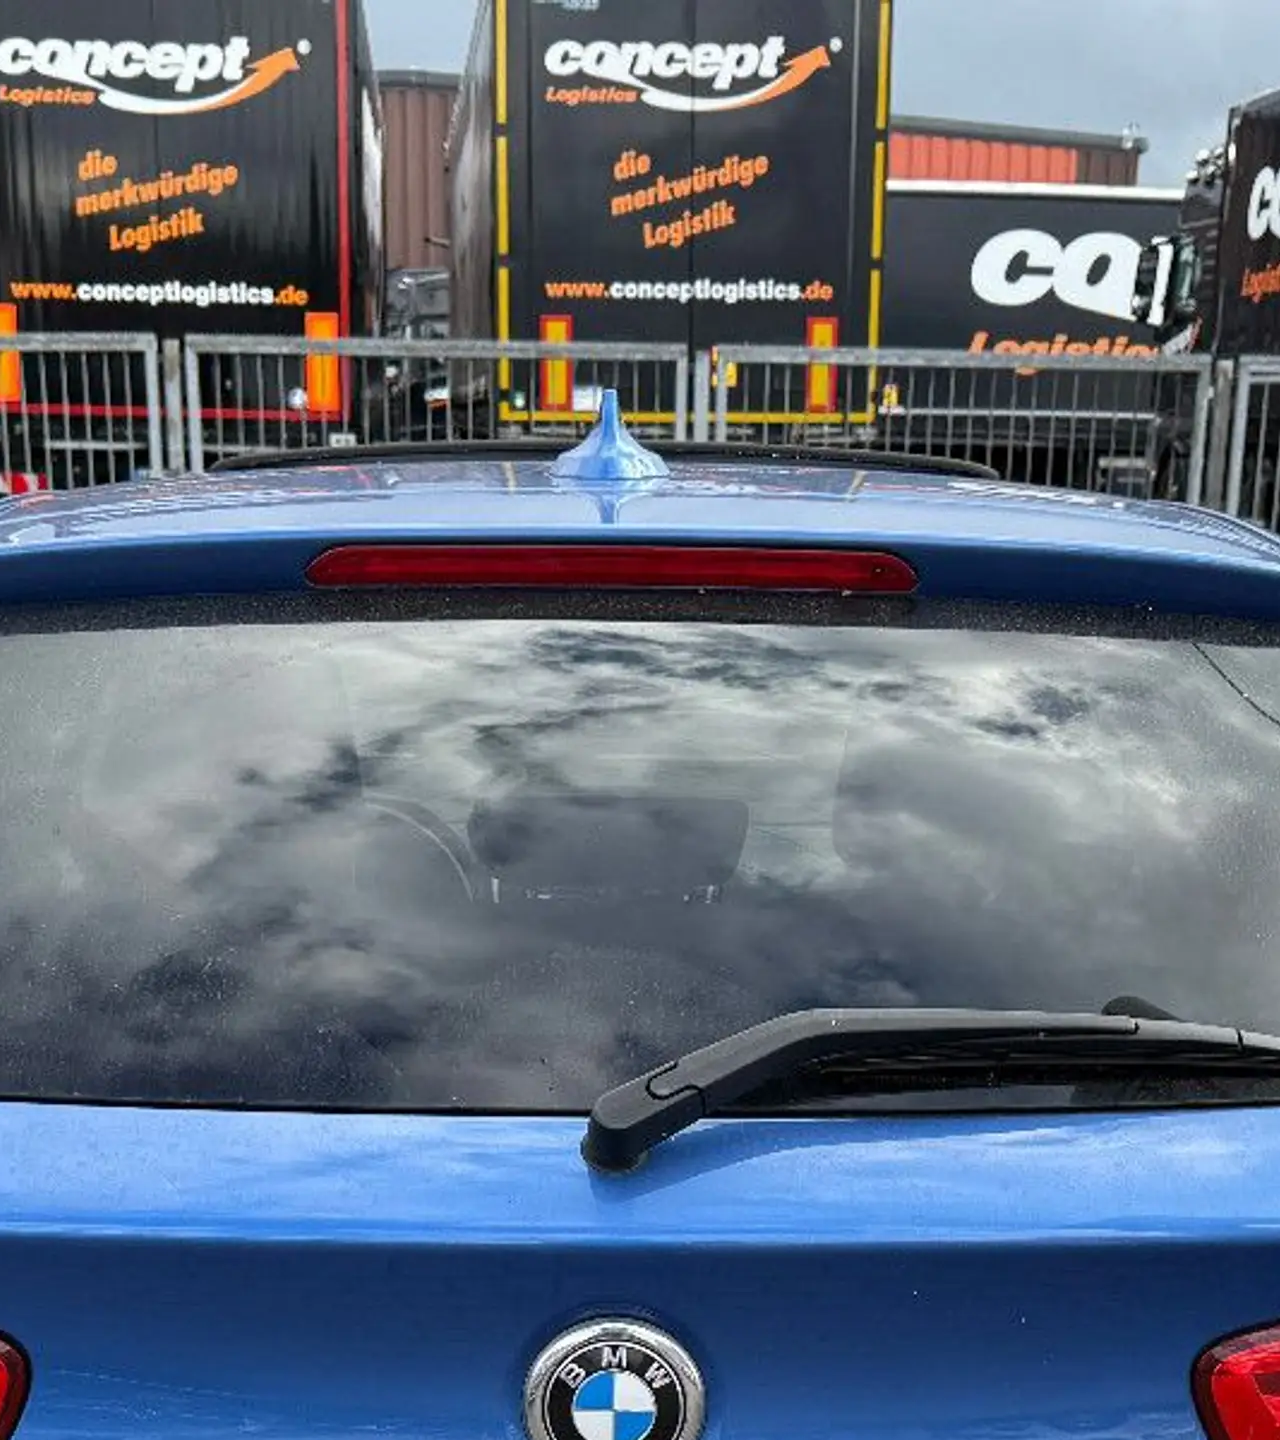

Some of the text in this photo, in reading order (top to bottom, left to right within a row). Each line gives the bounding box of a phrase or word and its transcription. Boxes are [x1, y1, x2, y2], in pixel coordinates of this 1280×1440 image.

[544, 36, 785, 90] concept
[545, 86, 638, 105] Logistics
[77, 151, 118, 182] die
[609, 154, 769, 217] merkwürdige
[613, 150, 651, 181] die
[75, 162, 238, 217] merkwürdige
[108, 207, 205, 253] Logistik
[643, 200, 736, 249] Logistik
[9, 278, 310, 308] www.conceptlogistics.de
[544, 277, 835, 305] www.conceptlogistics.de
[560, 1346, 672, 1390] BMW
